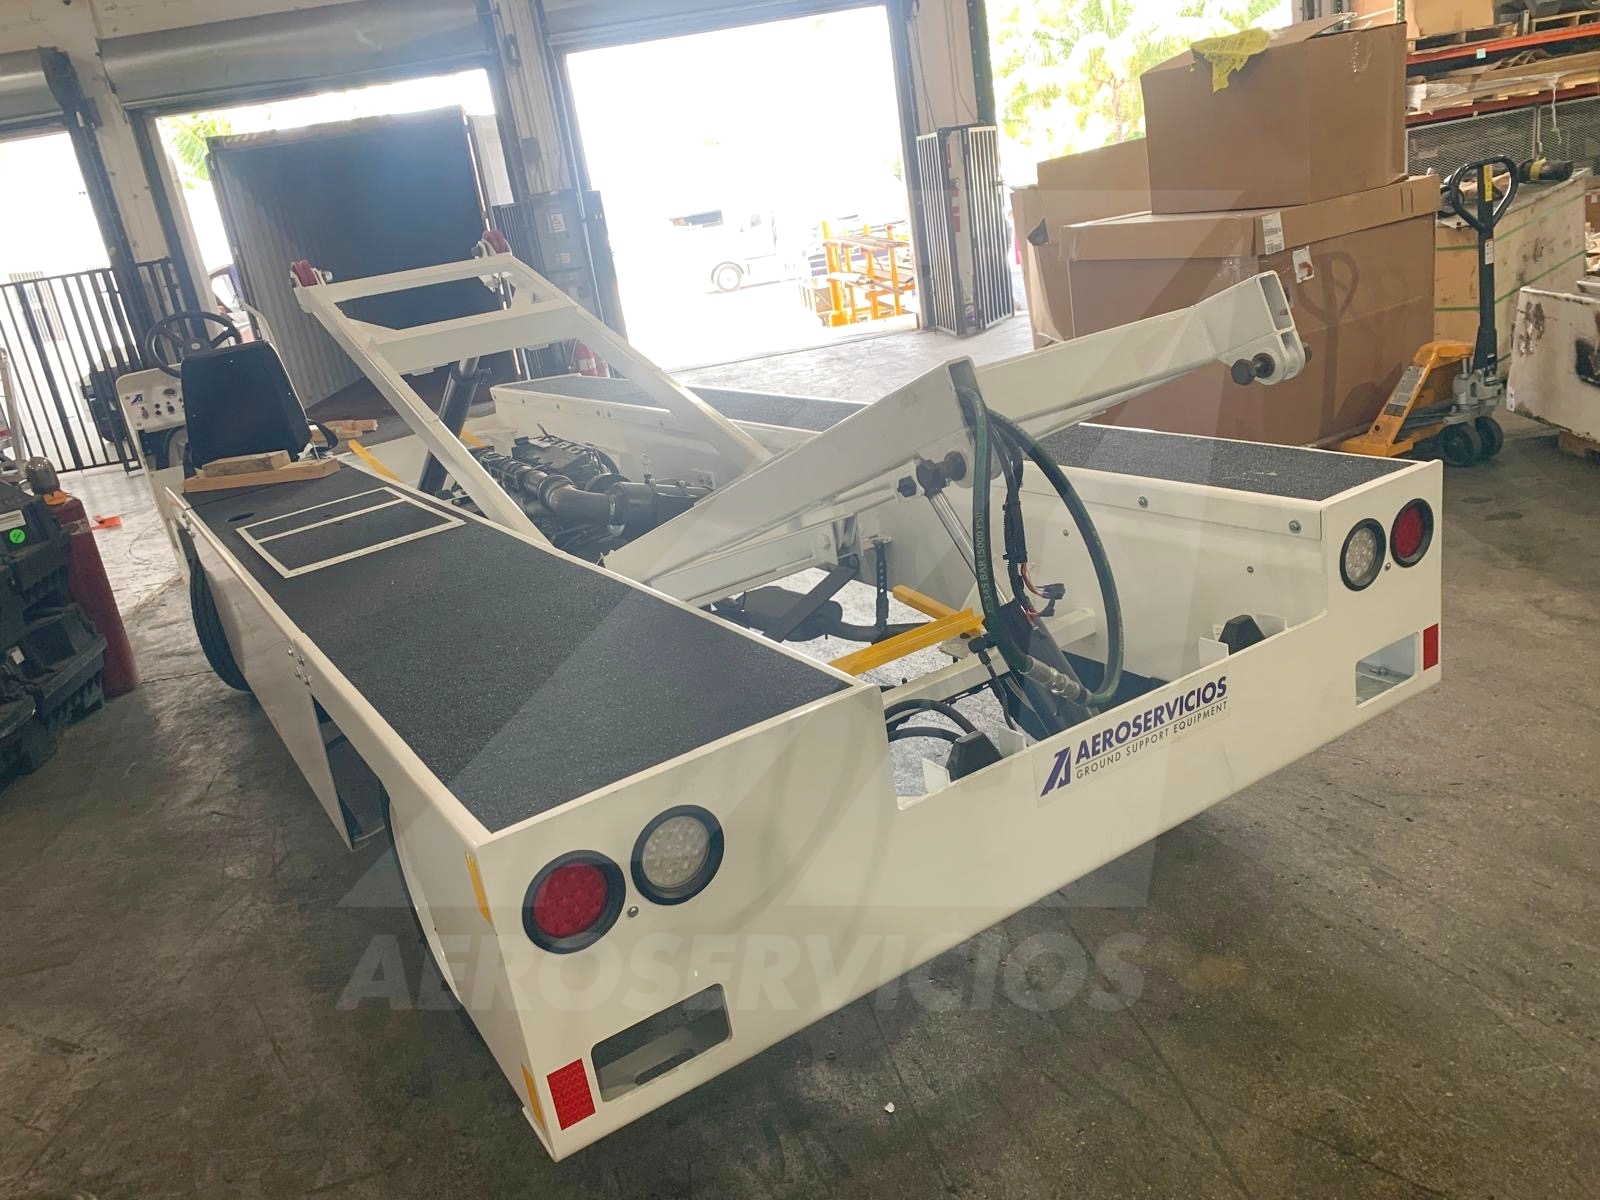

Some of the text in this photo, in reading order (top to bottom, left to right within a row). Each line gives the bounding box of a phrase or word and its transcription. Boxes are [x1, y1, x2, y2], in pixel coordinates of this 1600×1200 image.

[976, 532, 985, 558] (5000
[978, 559, 989, 580] BAR
[1075, 675, 1228, 765] AEROSERVICIOS
[1076, 700, 1228, 779] GROUND SUPPORT EQUIPMENT
